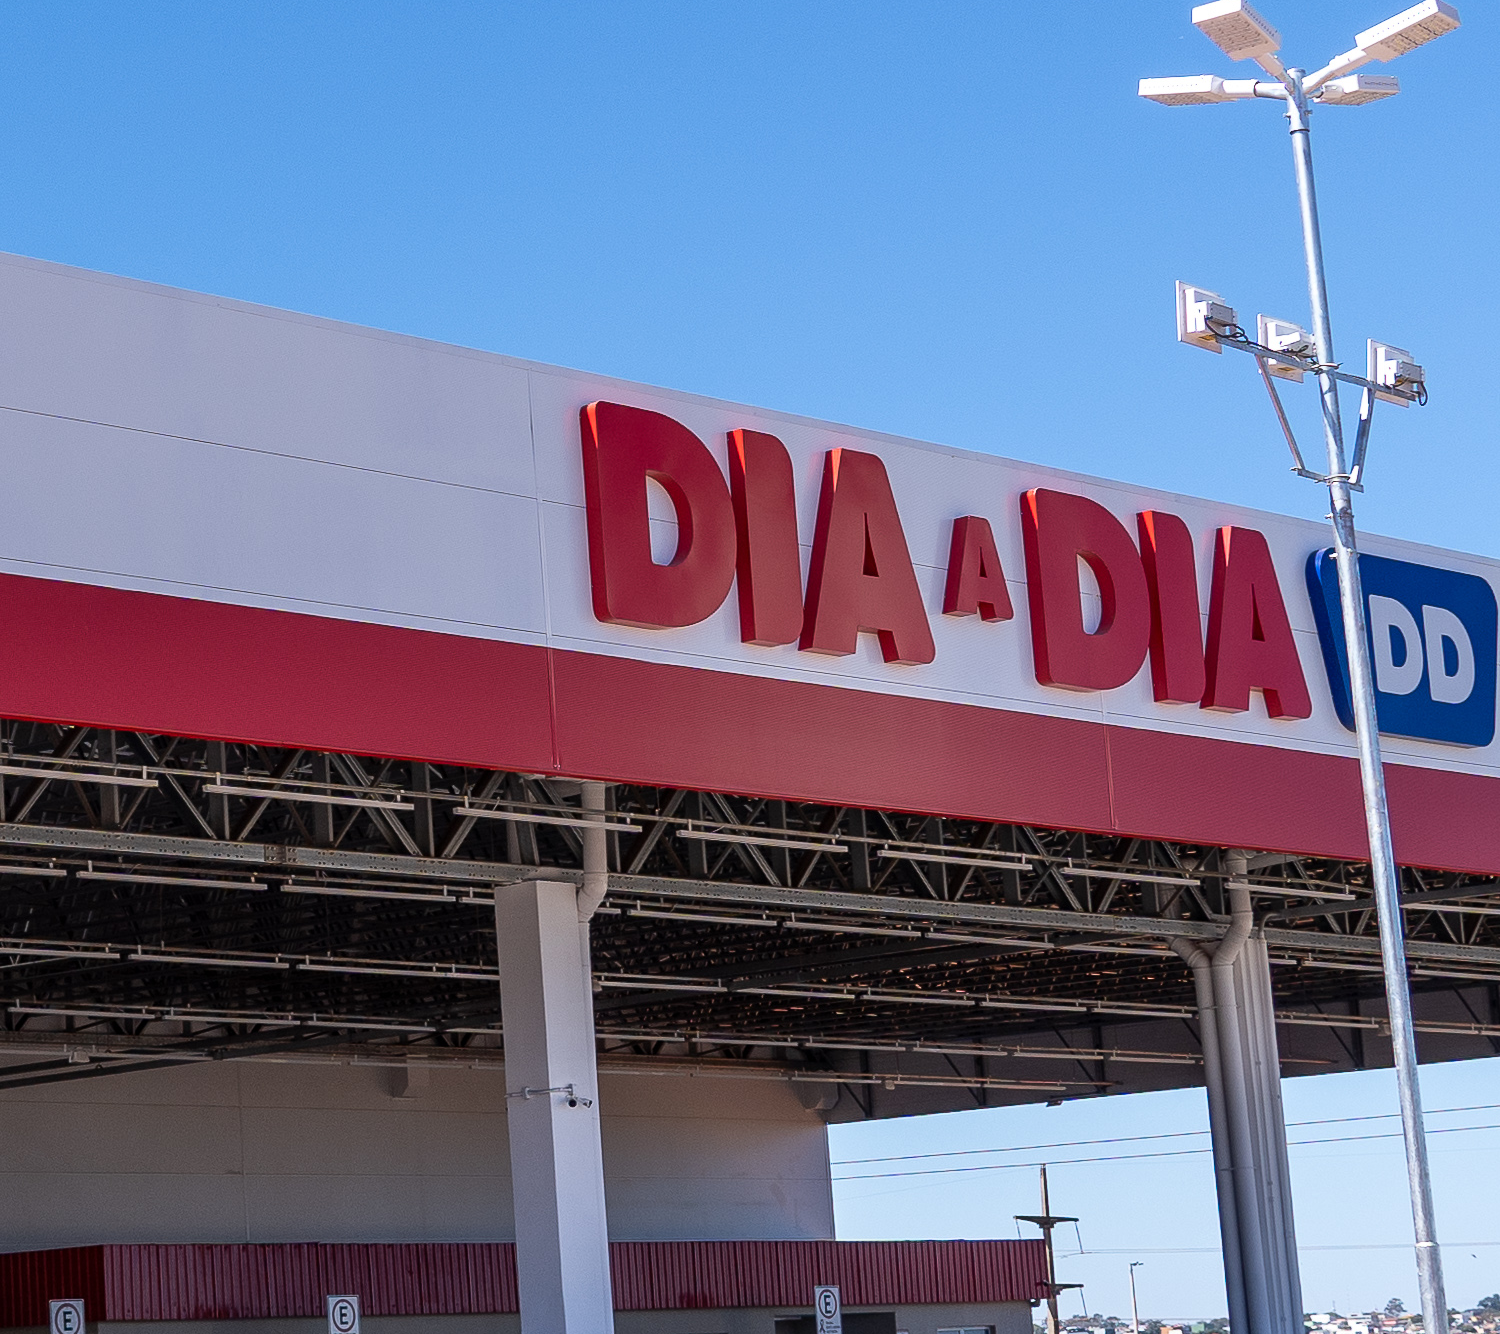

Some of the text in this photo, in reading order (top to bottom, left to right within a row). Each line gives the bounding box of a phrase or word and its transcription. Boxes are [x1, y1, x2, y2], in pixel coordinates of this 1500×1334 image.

[581, 400, 1313, 721] DIA A DIA
[1367, 594, 1476, 705] DD
[823, 1294, 832, 1314] E
[63, 1311, 73, 1331] E
[339, 1305, 349, 1325] E
